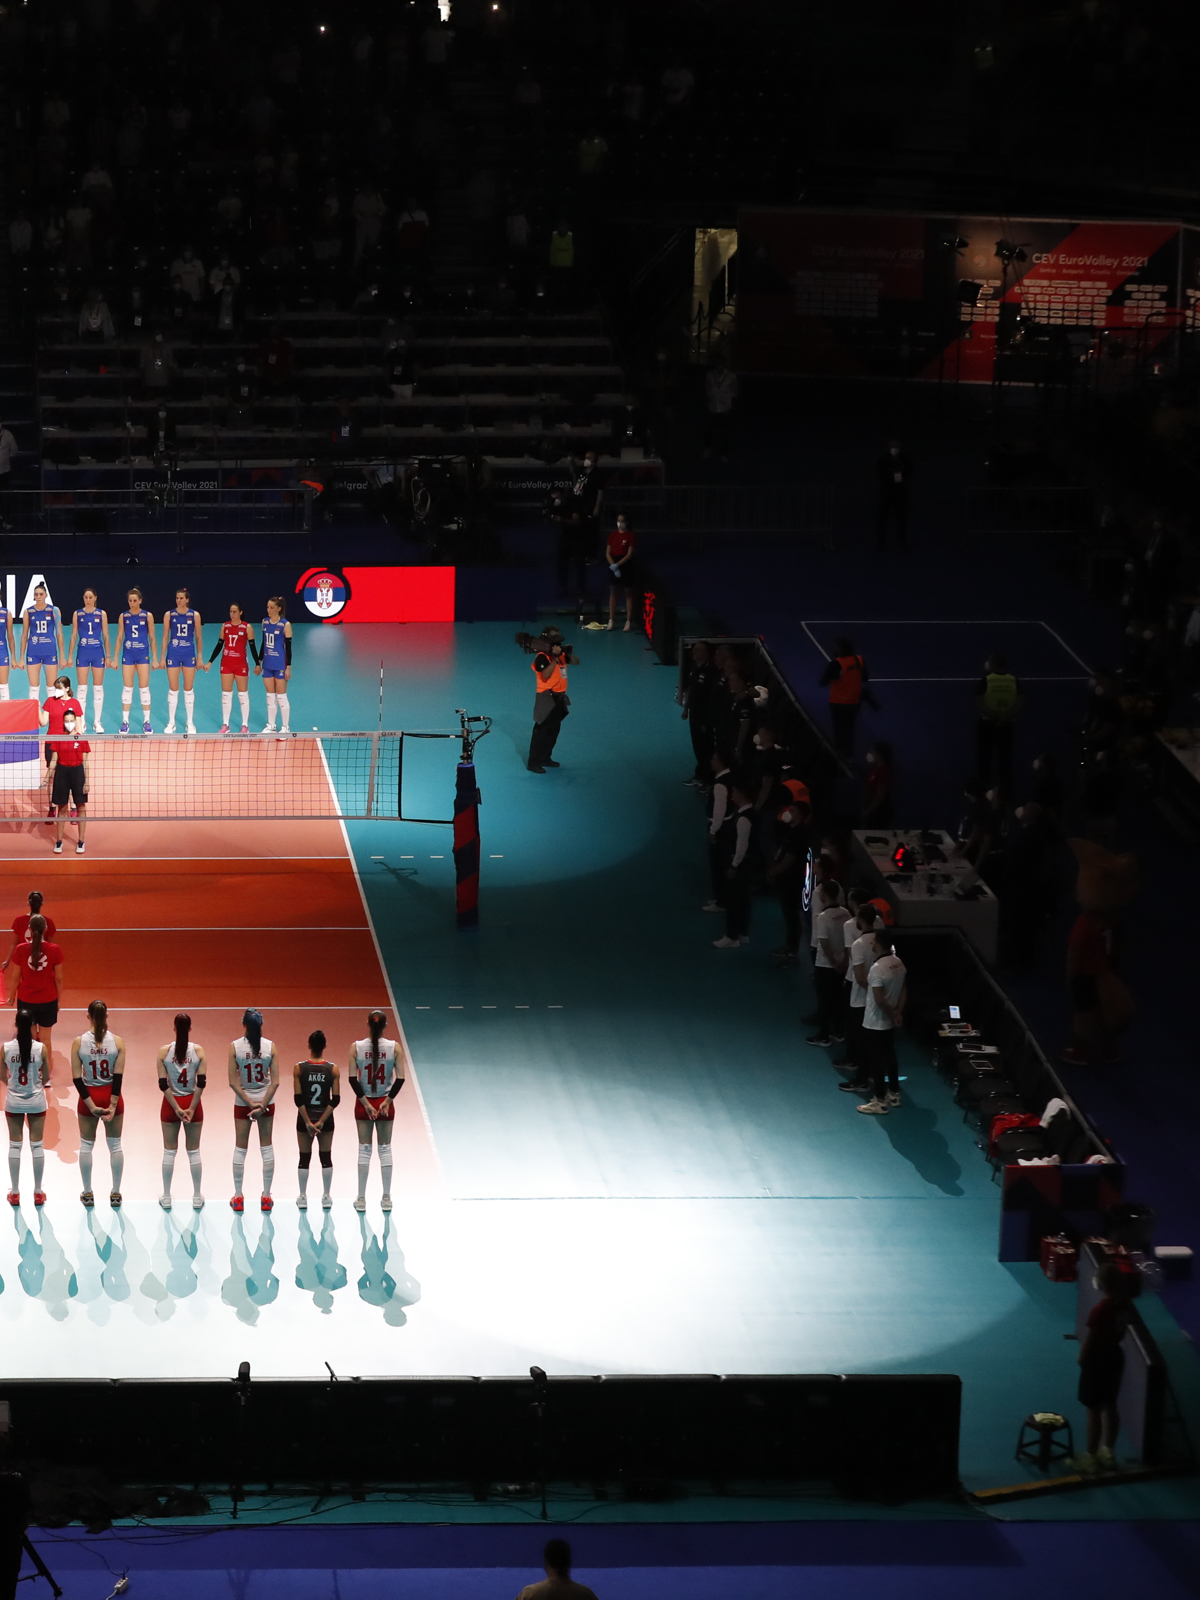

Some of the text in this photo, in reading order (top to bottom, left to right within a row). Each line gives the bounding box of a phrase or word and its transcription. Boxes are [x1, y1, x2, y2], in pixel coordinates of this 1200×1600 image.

[1032, 253, 1148, 268] CEV EuroVolley 2021
[199, 481, 218, 489] 2021
[508, 481, 552, 490] EuroVolley
[36, 620, 48, 633] 18
[88, 622, 94, 635] 1
[132, 625, 139, 637] 5
[176, 623, 188, 636] 13
[228, 634, 238, 647] 17
[265, 632, 275, 647] 10
[365, 1051, 387, 1060] EREM
[18, 1065, 28, 1086] 8
[88, 1059, 111, 1080] 18
[243, 1063, 265, 1083] 13
[364, 1063, 386, 1085] 14
[177, 1068, 188, 1088] 4
[308, 1073, 326, 1082] AKÖZ
[310, 1083, 322, 1105] 2
